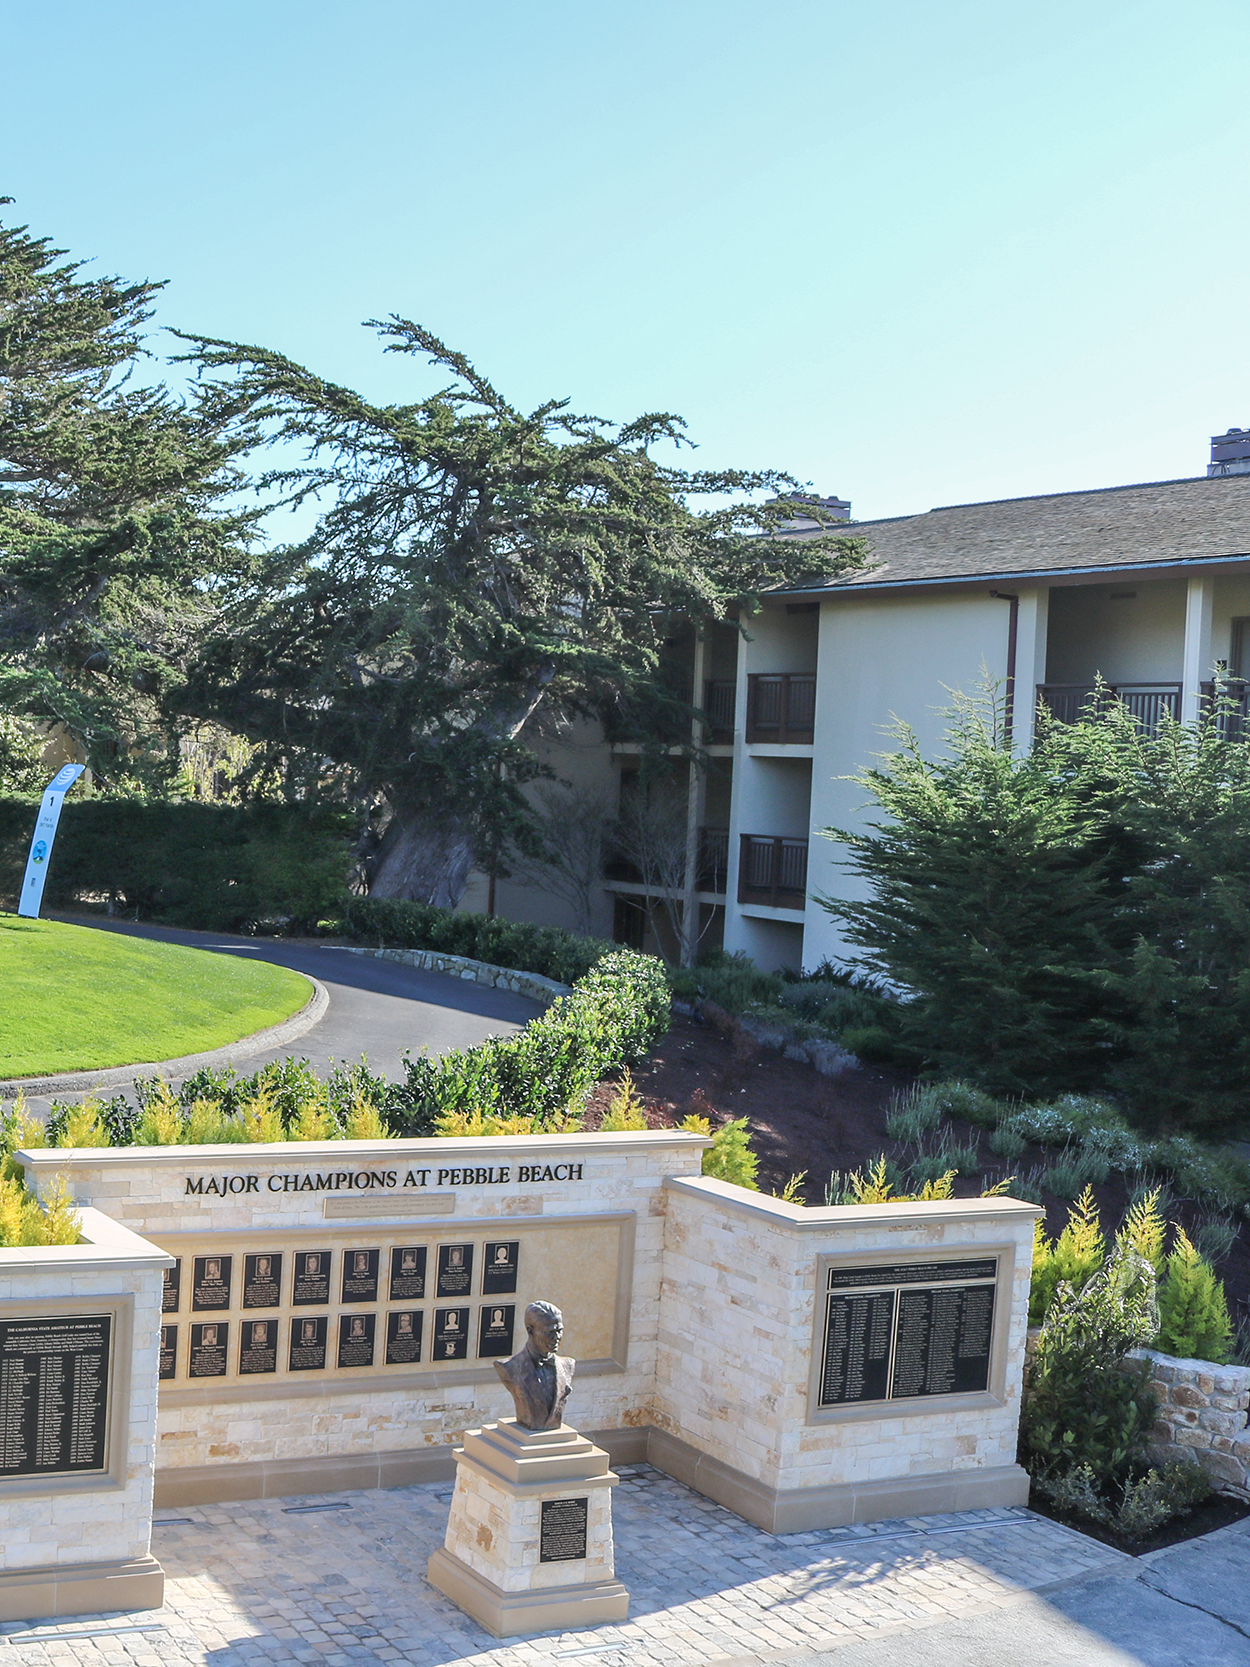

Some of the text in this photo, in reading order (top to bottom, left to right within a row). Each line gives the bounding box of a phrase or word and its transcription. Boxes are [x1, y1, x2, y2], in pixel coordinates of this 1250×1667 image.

[50, 797, 54, 806] 1
[185, 1164, 583, 1198] MAJOR CHAMPIONS AT PEBBLE BEACH
